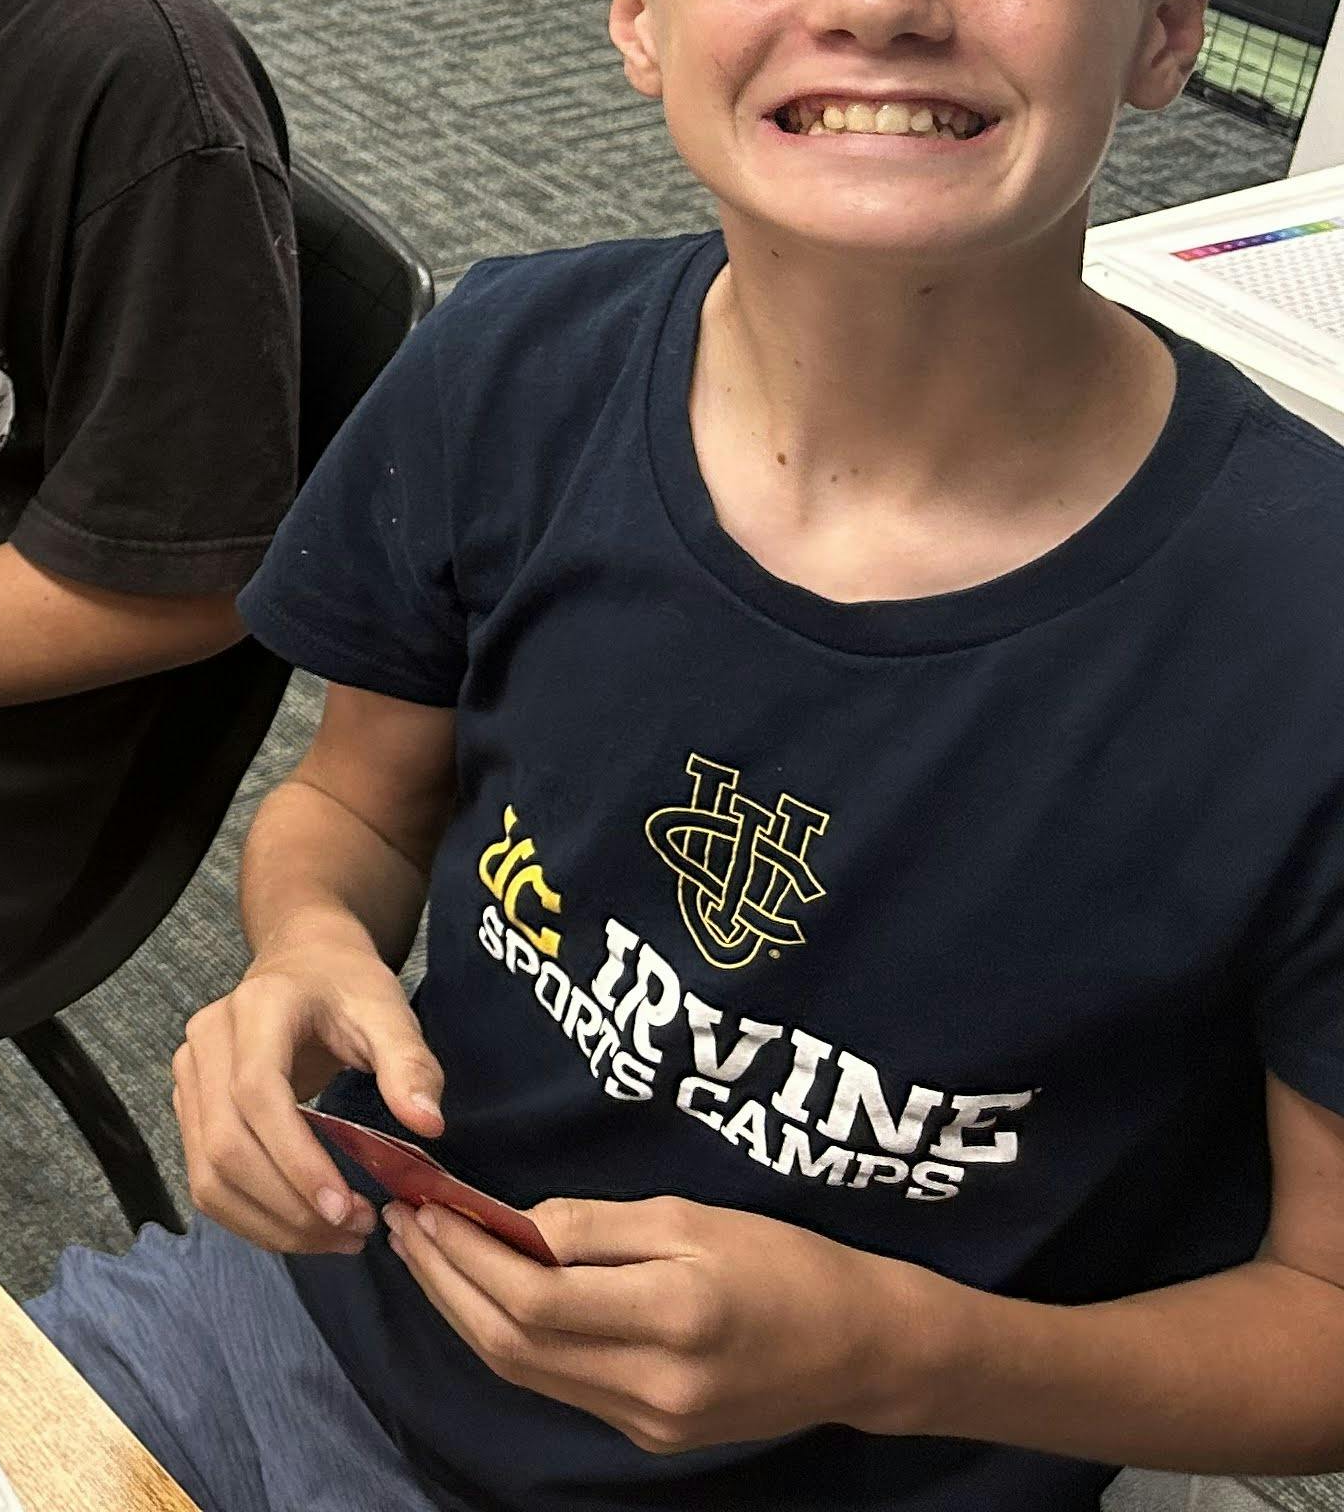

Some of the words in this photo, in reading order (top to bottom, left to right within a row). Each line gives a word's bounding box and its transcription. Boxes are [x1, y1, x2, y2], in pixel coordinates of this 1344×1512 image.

[478, 905, 655, 1102] SPORTS
[676, 1077, 965, 1200] CAMPS
[479, 804, 561, 958] UC
[591, 918, 1034, 1165] IRVINE
